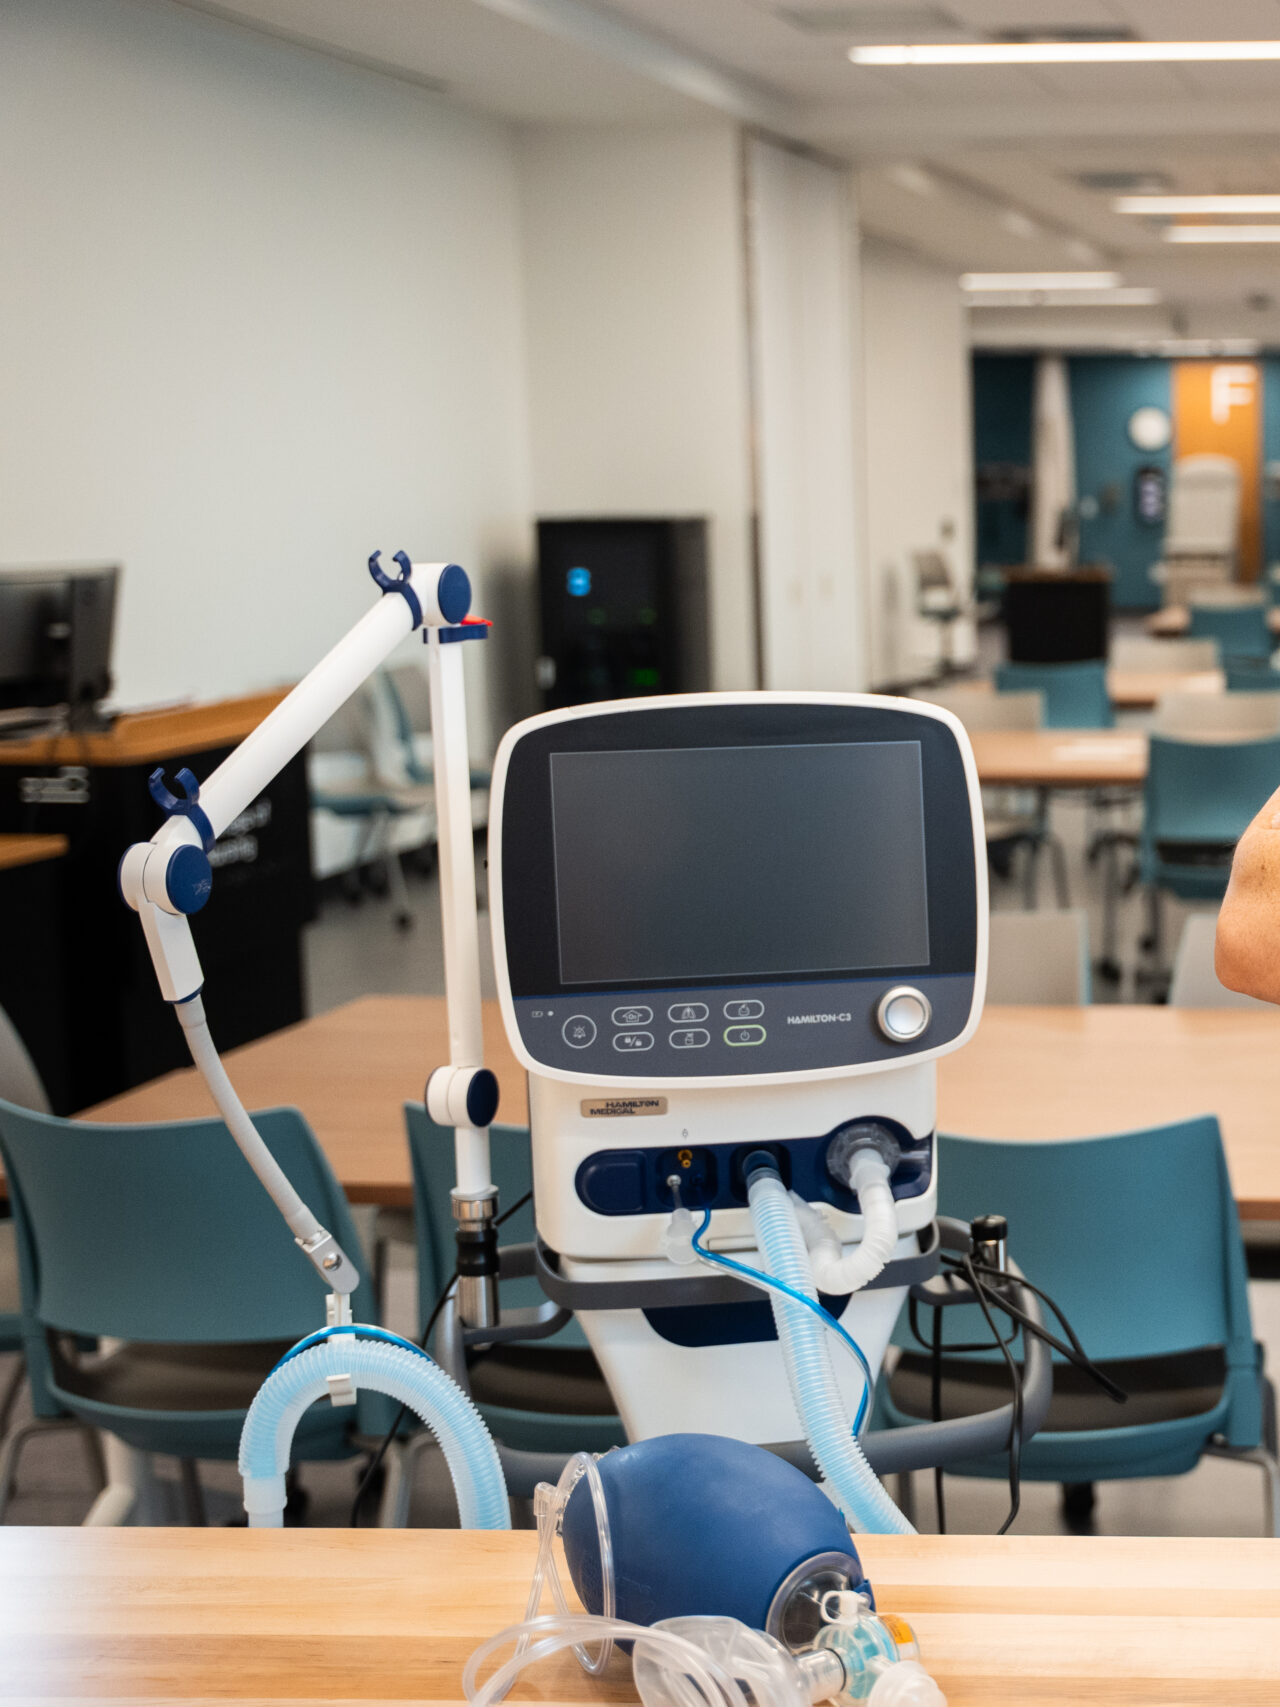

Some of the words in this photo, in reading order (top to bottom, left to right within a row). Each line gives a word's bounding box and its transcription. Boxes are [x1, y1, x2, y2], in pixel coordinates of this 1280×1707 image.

[1210, 366, 1256, 424] F
[787, 1012, 851, 1024] HAMILTON-C3
[606, 1100, 660, 1108] HAMILTON
[590, 1107, 635, 1115] MEDICAL
